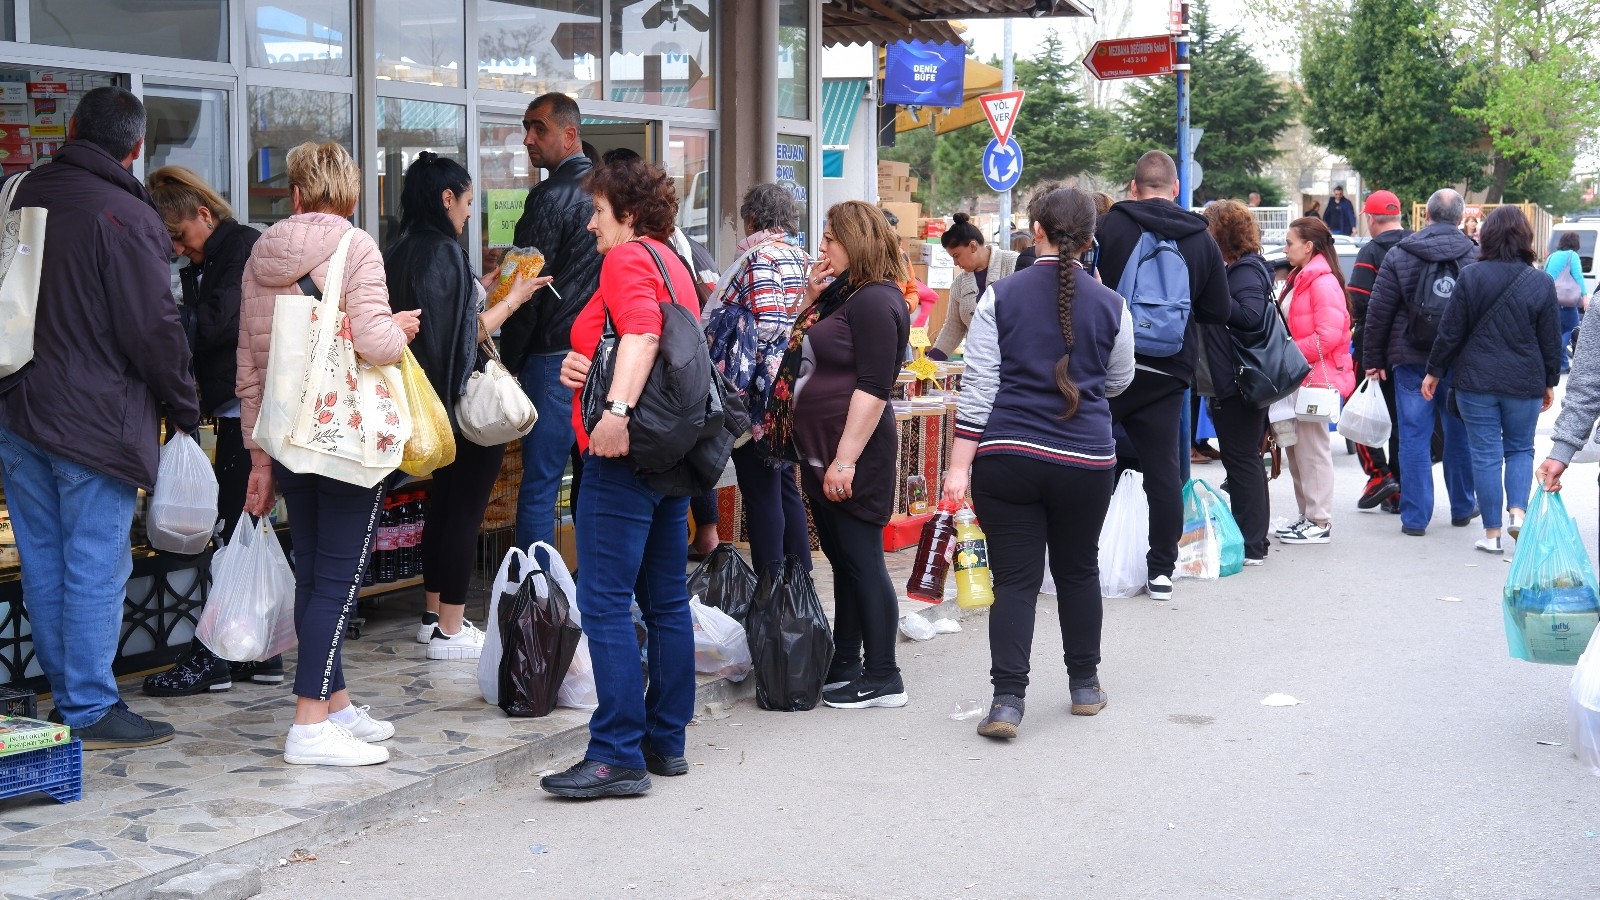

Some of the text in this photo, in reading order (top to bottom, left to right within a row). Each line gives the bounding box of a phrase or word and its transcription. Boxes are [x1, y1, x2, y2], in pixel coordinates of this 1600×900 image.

[1109, 42, 1168, 56] MEZBAHA DEĞİRMEN Sokak
[913, 64, 938, 73] DENİZ
[914, 72, 936, 81] BÜFE
[994, 112, 1010, 121] VER
[494, 201, 523, 210] BAKLAVA
[501, 220, 509, 229] 50
[324, 648, 337, 676] WHERE
[320, 677, 330, 695] AND
